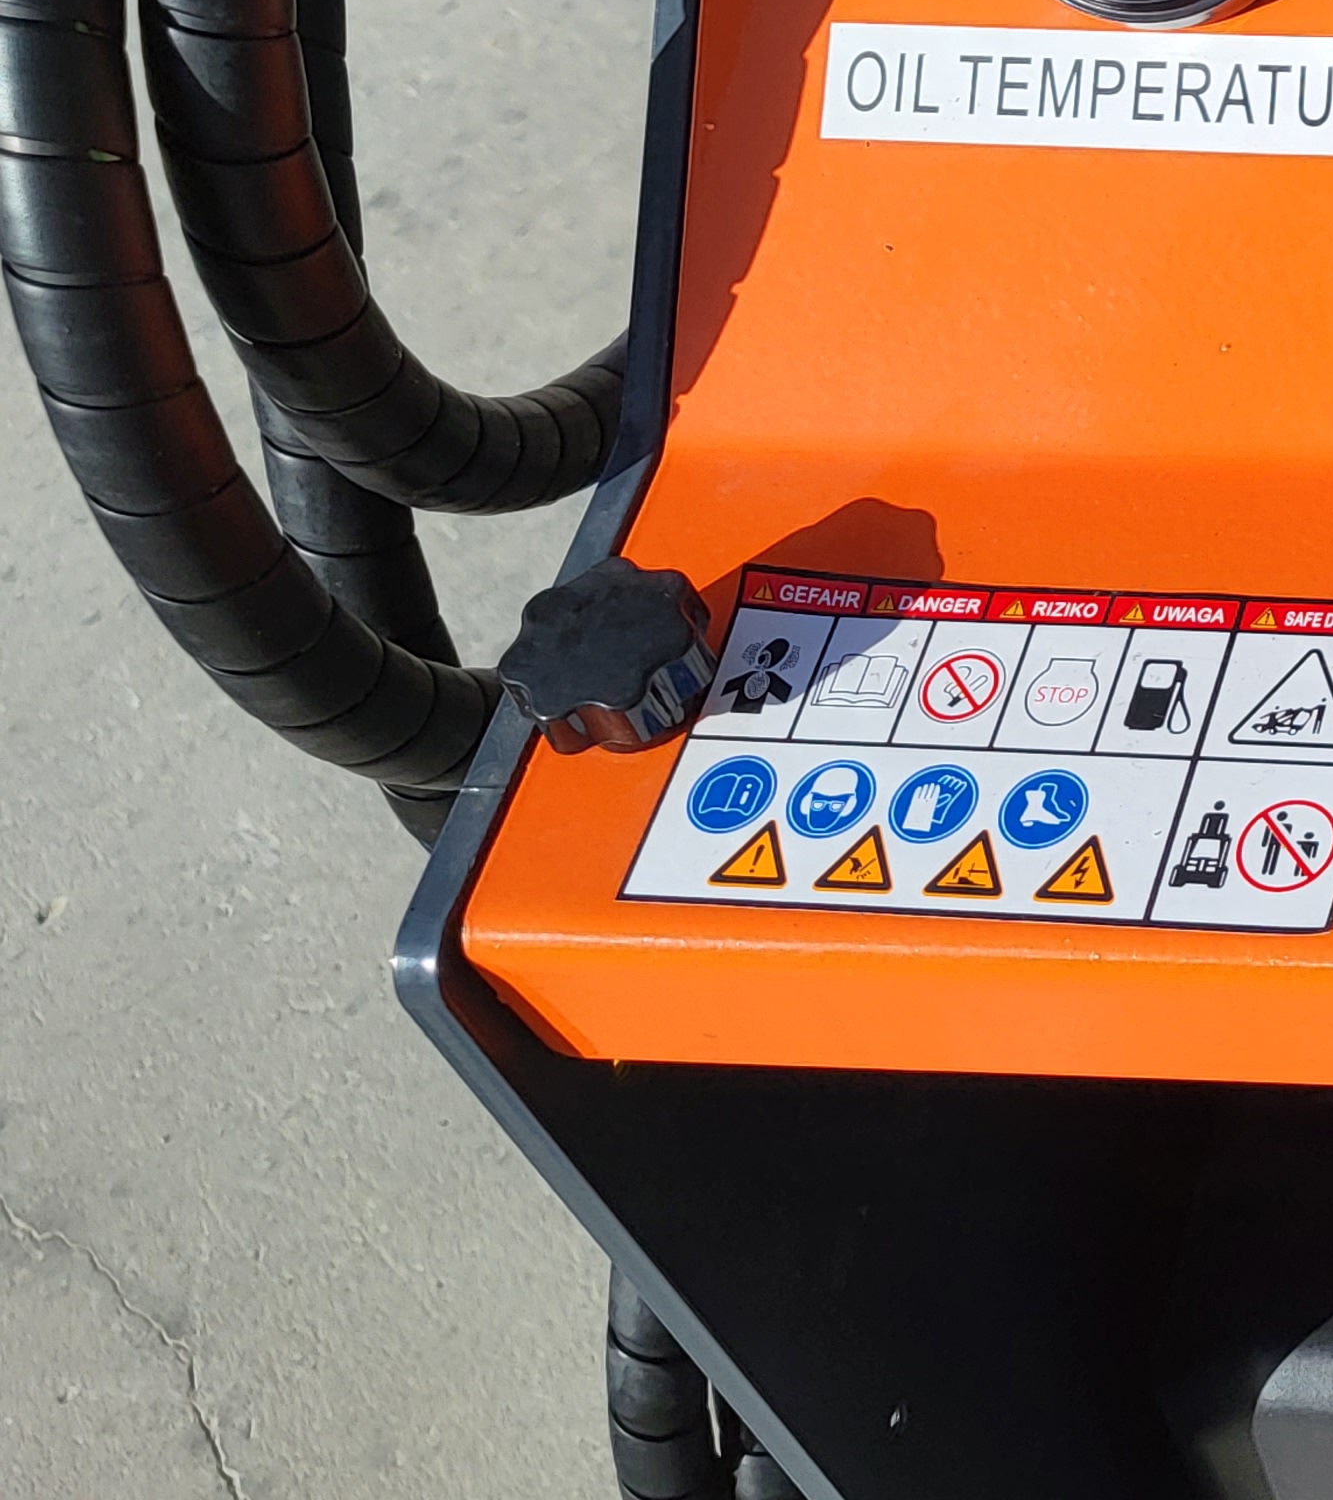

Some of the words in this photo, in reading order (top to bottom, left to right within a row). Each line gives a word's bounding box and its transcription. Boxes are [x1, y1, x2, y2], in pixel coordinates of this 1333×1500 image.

[846, 50, 940, 114] OIL
[779, 583, 861, 609] GEFAHR
[897, 594, 982, 615] DANGER
[1031, 600, 1099, 619] RIZIKO
[1152, 605, 1225, 625] UWAGA
[1284, 610, 1323, 628] SAFE
[1034, 685, 1089, 704] STOP
